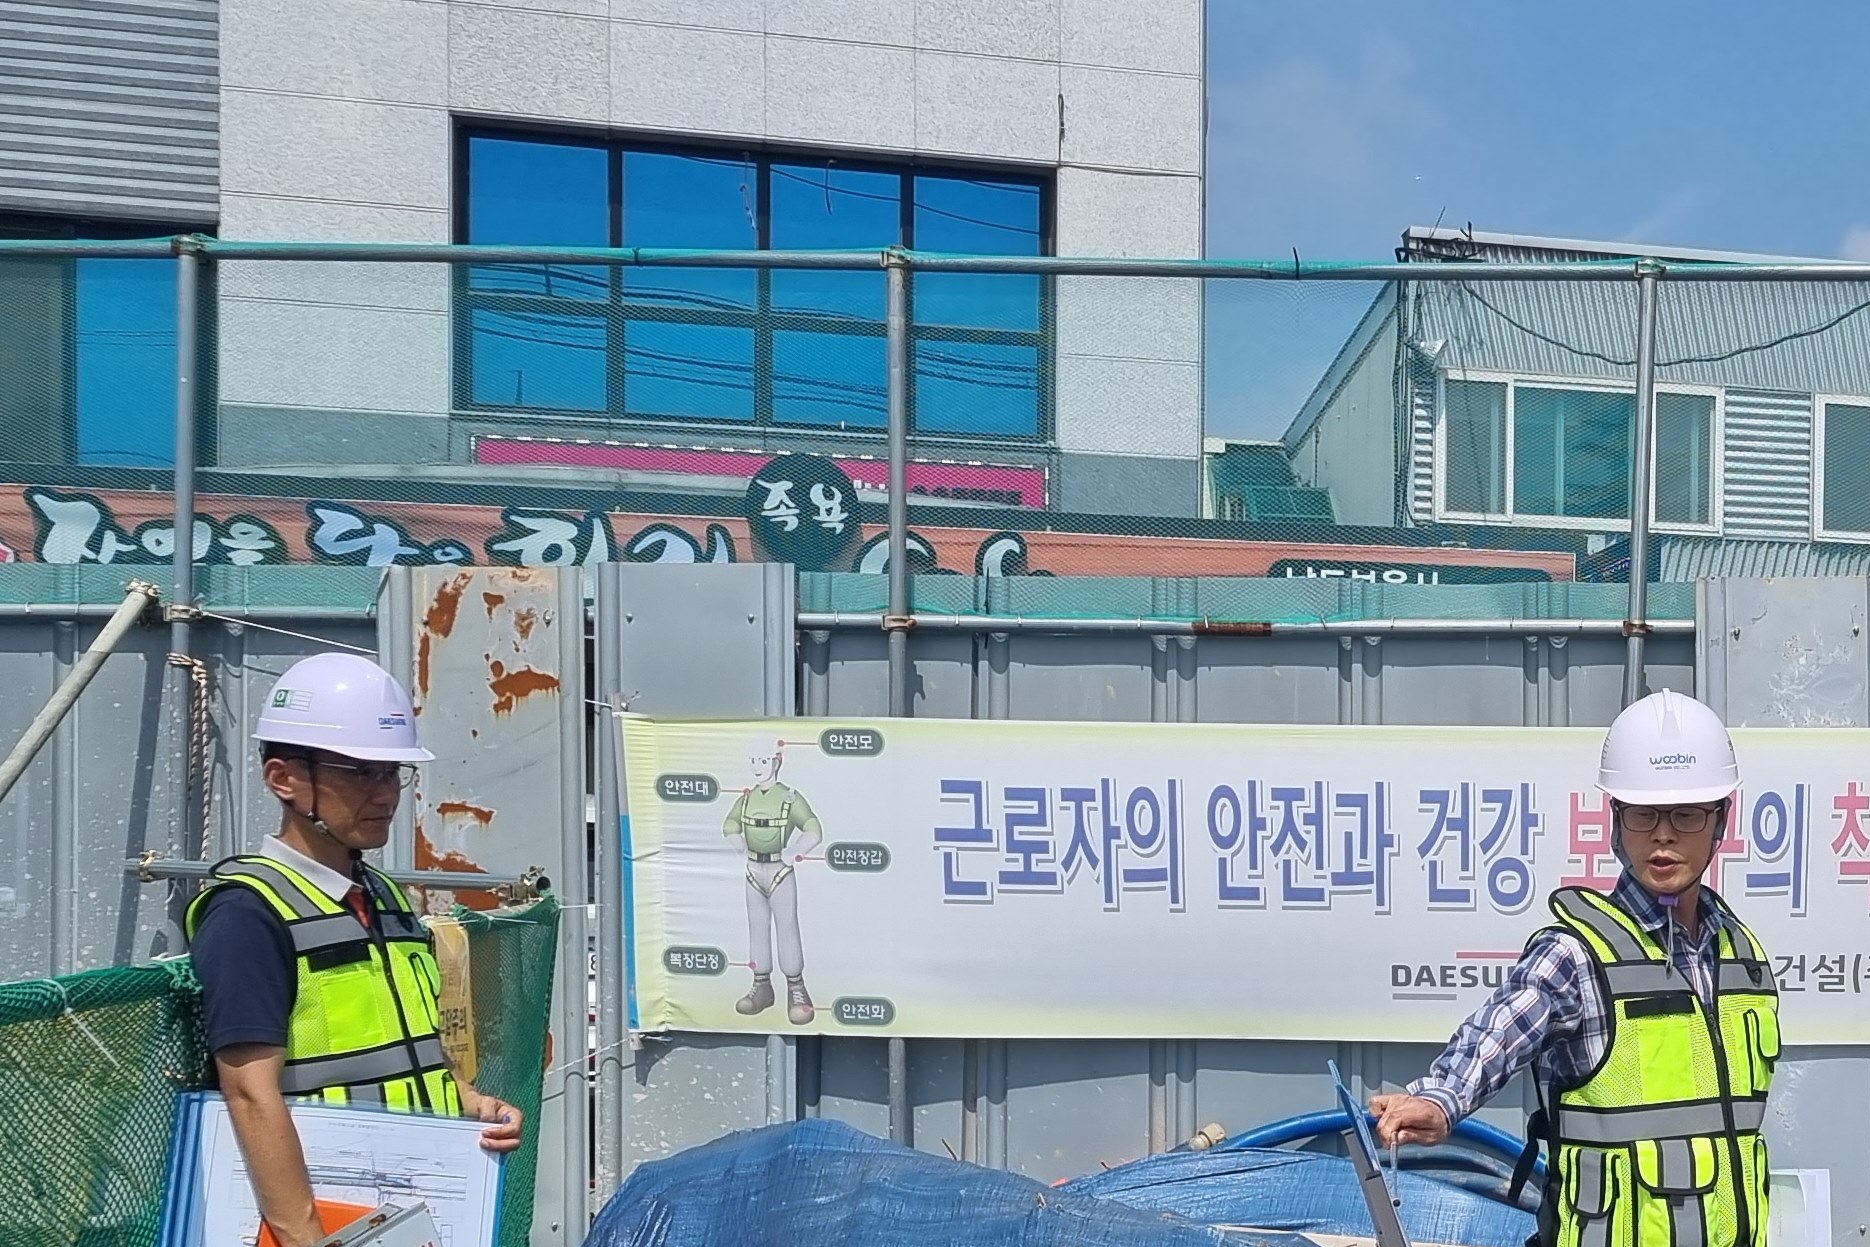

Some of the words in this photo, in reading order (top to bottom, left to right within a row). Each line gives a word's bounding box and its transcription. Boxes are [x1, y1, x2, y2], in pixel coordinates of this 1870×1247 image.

[756, 479, 849, 535] 족욕
[829, 734, 873, 751] 안전모
[1649, 752, 1697, 765] woobin
[664, 779, 710, 796] 안전대
[933, 776, 1185, 911] 근로자의
[1205, 779, 1395, 914] 안전과
[1416, 781, 1541, 917] 건강
[1560, 783, 1812, 918] 보의
[833, 848, 883, 866] 안전장갑
[669, 952, 720, 970] 복장단정
[1391, 963, 1515, 989] DAESU
[842, 1003, 886, 1020] 안전화
